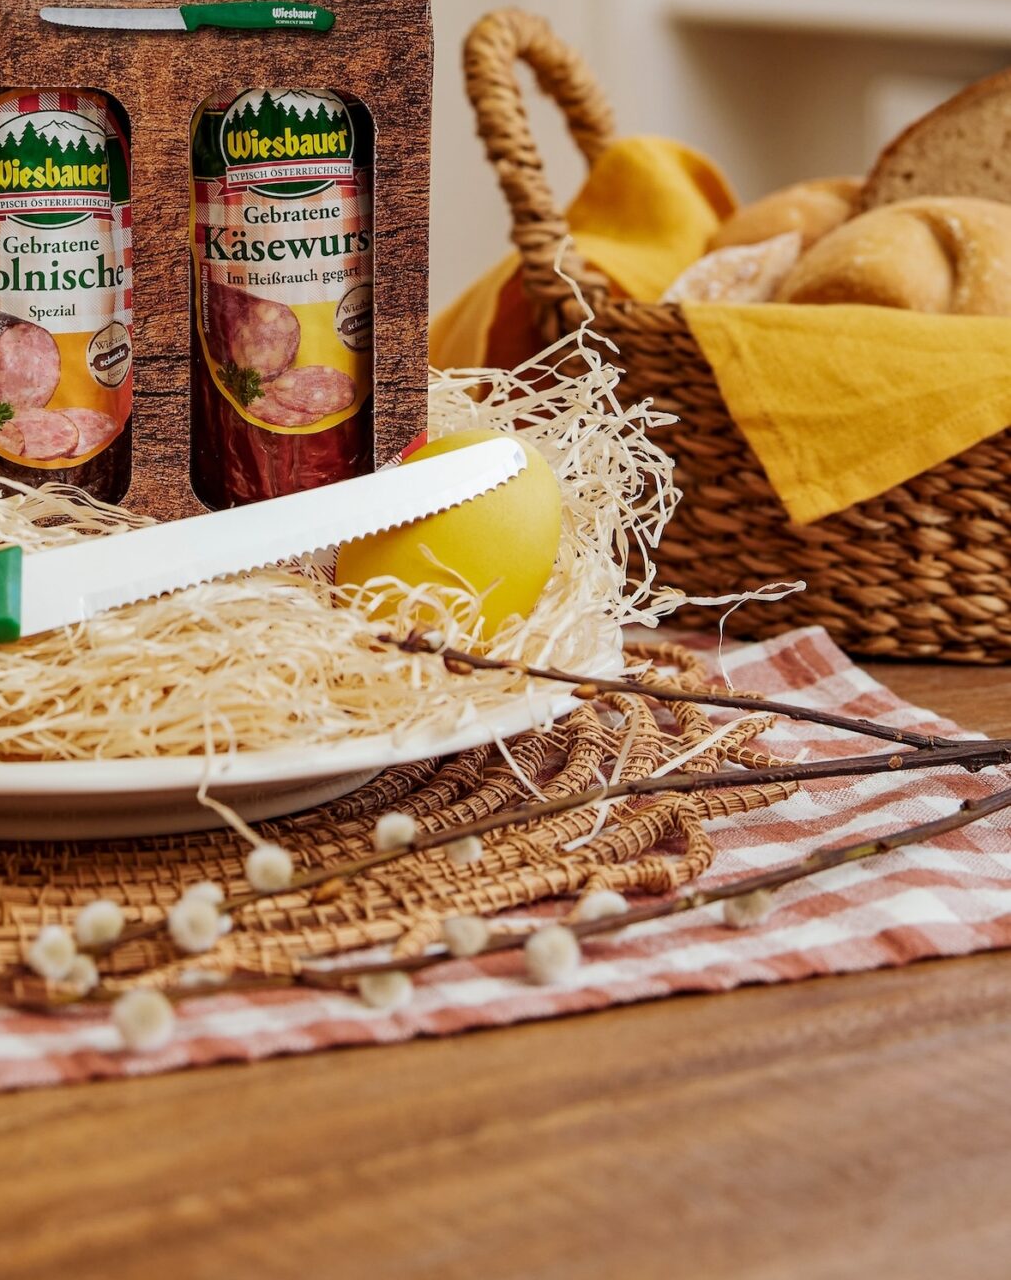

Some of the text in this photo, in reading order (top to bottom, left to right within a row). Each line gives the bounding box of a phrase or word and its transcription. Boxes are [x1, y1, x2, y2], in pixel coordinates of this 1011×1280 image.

[272, 7, 317, 19] Wiesbauer
[227, 126, 348, 159] Wiesbauer
[229, 164, 351, 181] TYPISCH ÖSTERREICHISCH
[30, 196, 110, 209] ÖSTERREICHISCH
[244, 206, 340, 224] Gebratene
[3, 236, 99, 254] Gebratene
[203, 226, 371, 262] Käsewurs
[227, 266, 358, 286] Im Heißrauch gegart
[201, 265, 210, 334] Serviervorschlag
[29, 304, 76, 319] Spezial
